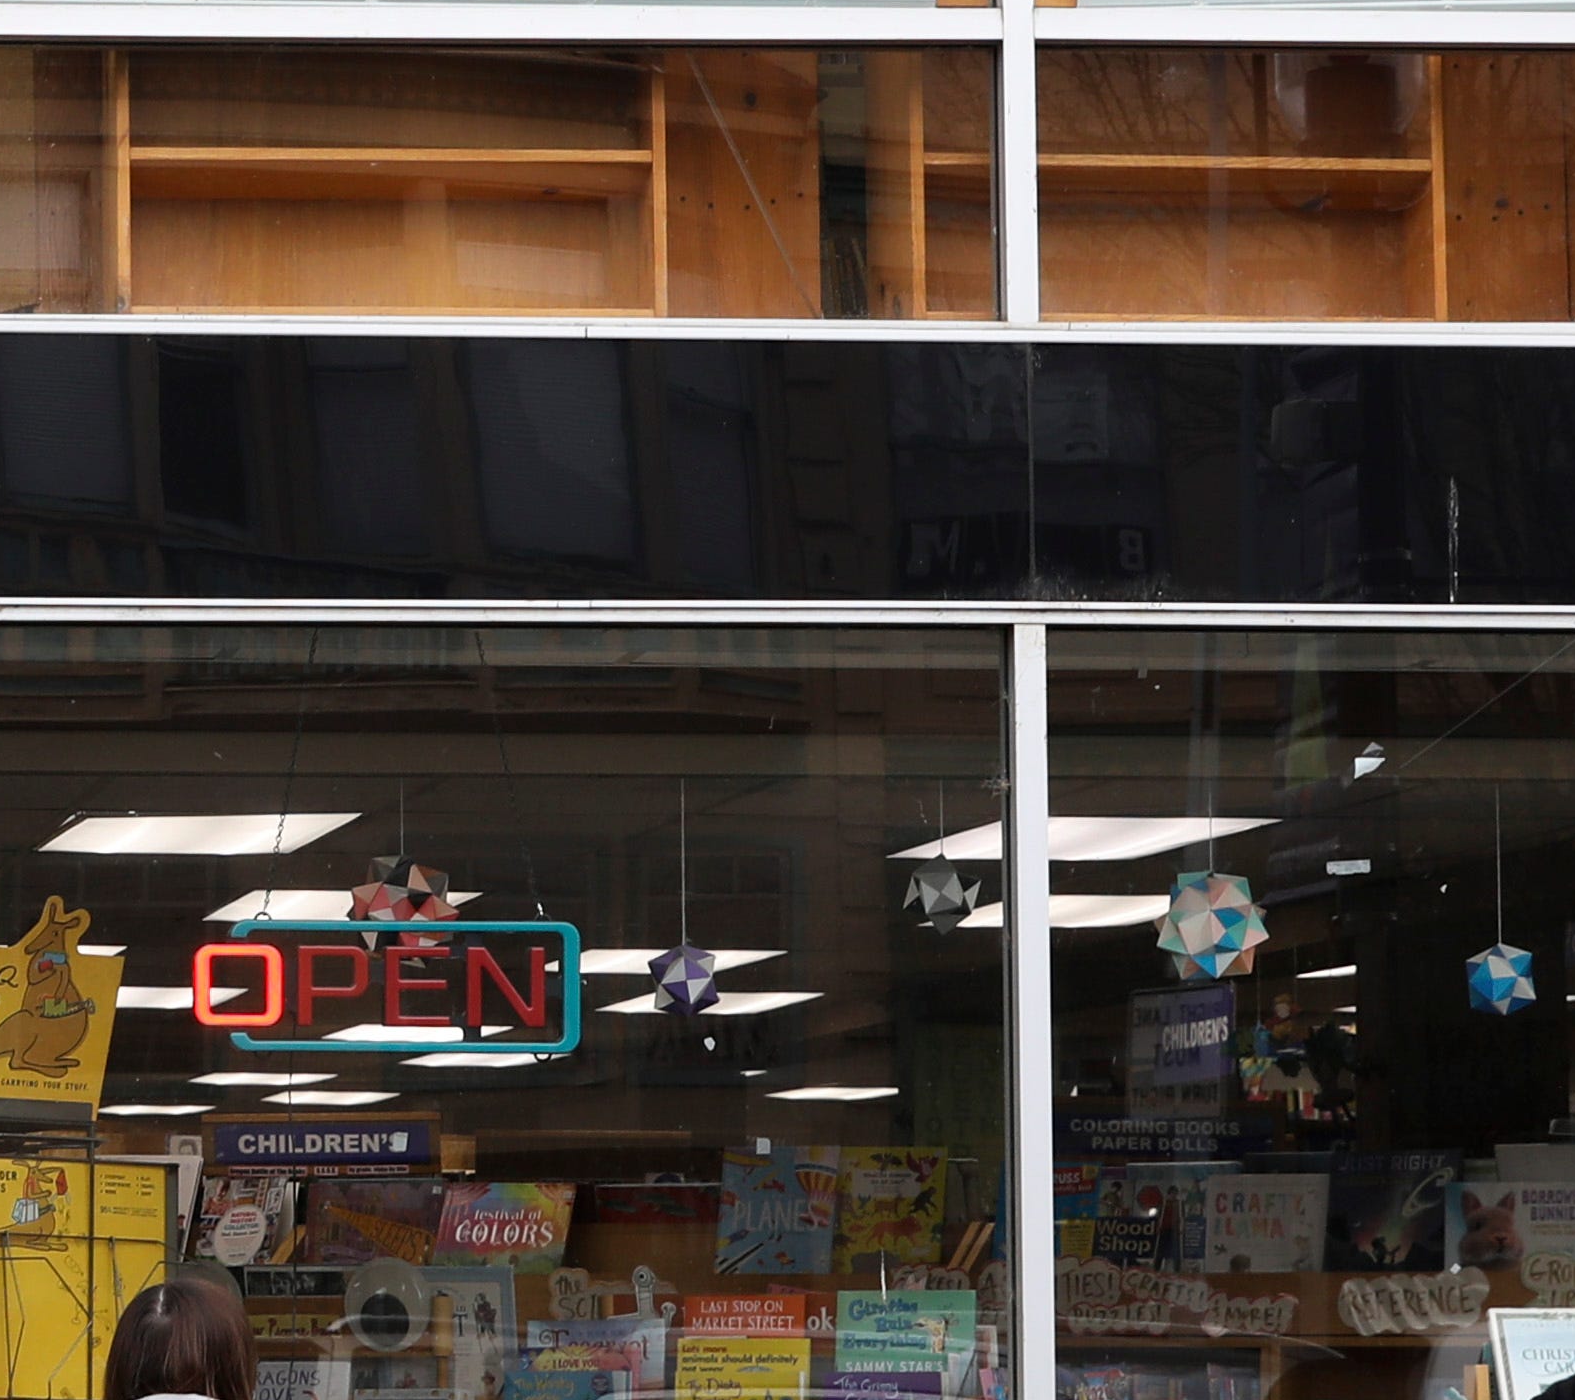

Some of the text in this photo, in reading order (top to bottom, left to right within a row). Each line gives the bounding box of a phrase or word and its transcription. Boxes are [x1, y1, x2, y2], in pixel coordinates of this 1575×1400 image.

[192, 943, 546, 1027] OPEN
[1161, 1016, 1229, 1052] CHILDREN'S
[1070, 1119, 1240, 1136] COLORING BOOKS
[1092, 1137, 1219, 1152] PAPER DOLLS
[474, 1208, 523, 1221] festival
[454, 1219, 554, 1247] COLORS
[1097, 1218, 1156, 1236] Wood
[1099, 1235, 1152, 1255] Shop
[701, 1301, 783, 1313] LAST STOP ON
[1349, 1281, 1475, 1320] REFERENCE
[692, 1317, 795, 1331] MARKET STREET
[682, 1354, 798, 1365] animals should definitely
